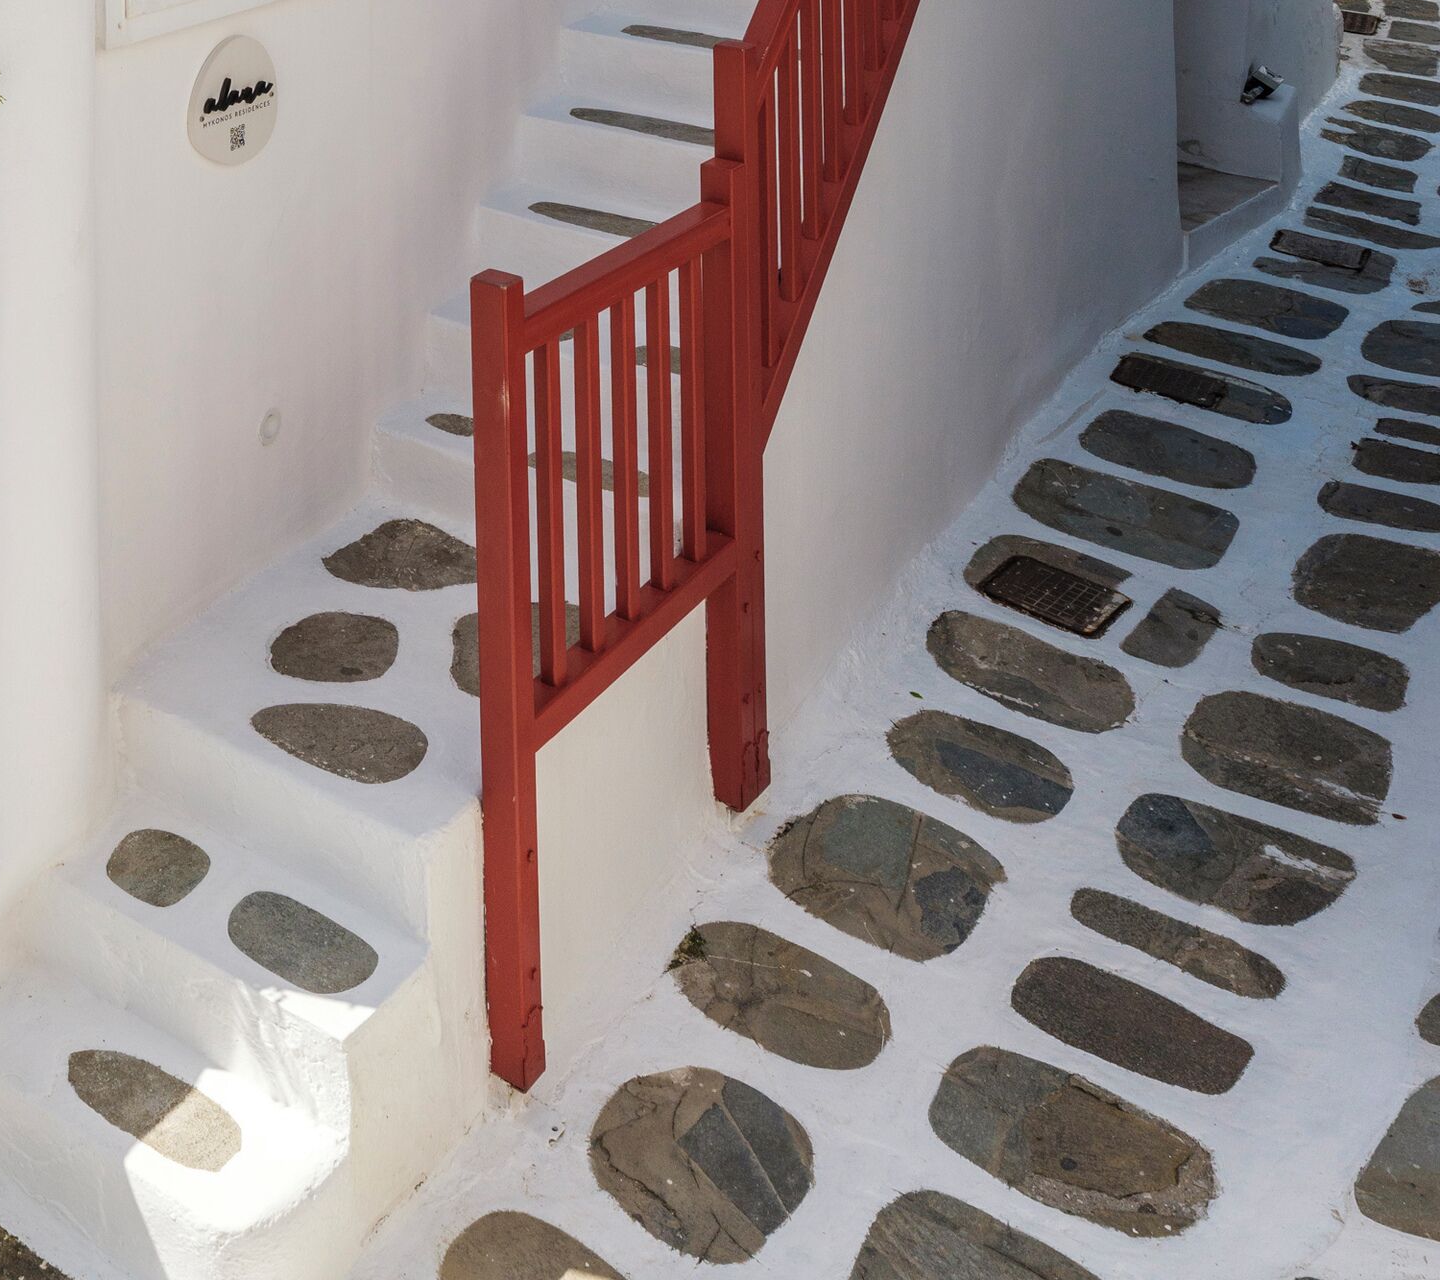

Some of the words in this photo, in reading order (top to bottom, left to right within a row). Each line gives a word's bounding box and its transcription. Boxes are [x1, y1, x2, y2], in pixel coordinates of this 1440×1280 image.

[203, 77, 274, 114] alana
[202, 113, 233, 129] MYKONOS
[234, 100, 271, 118] RESIDENCES
